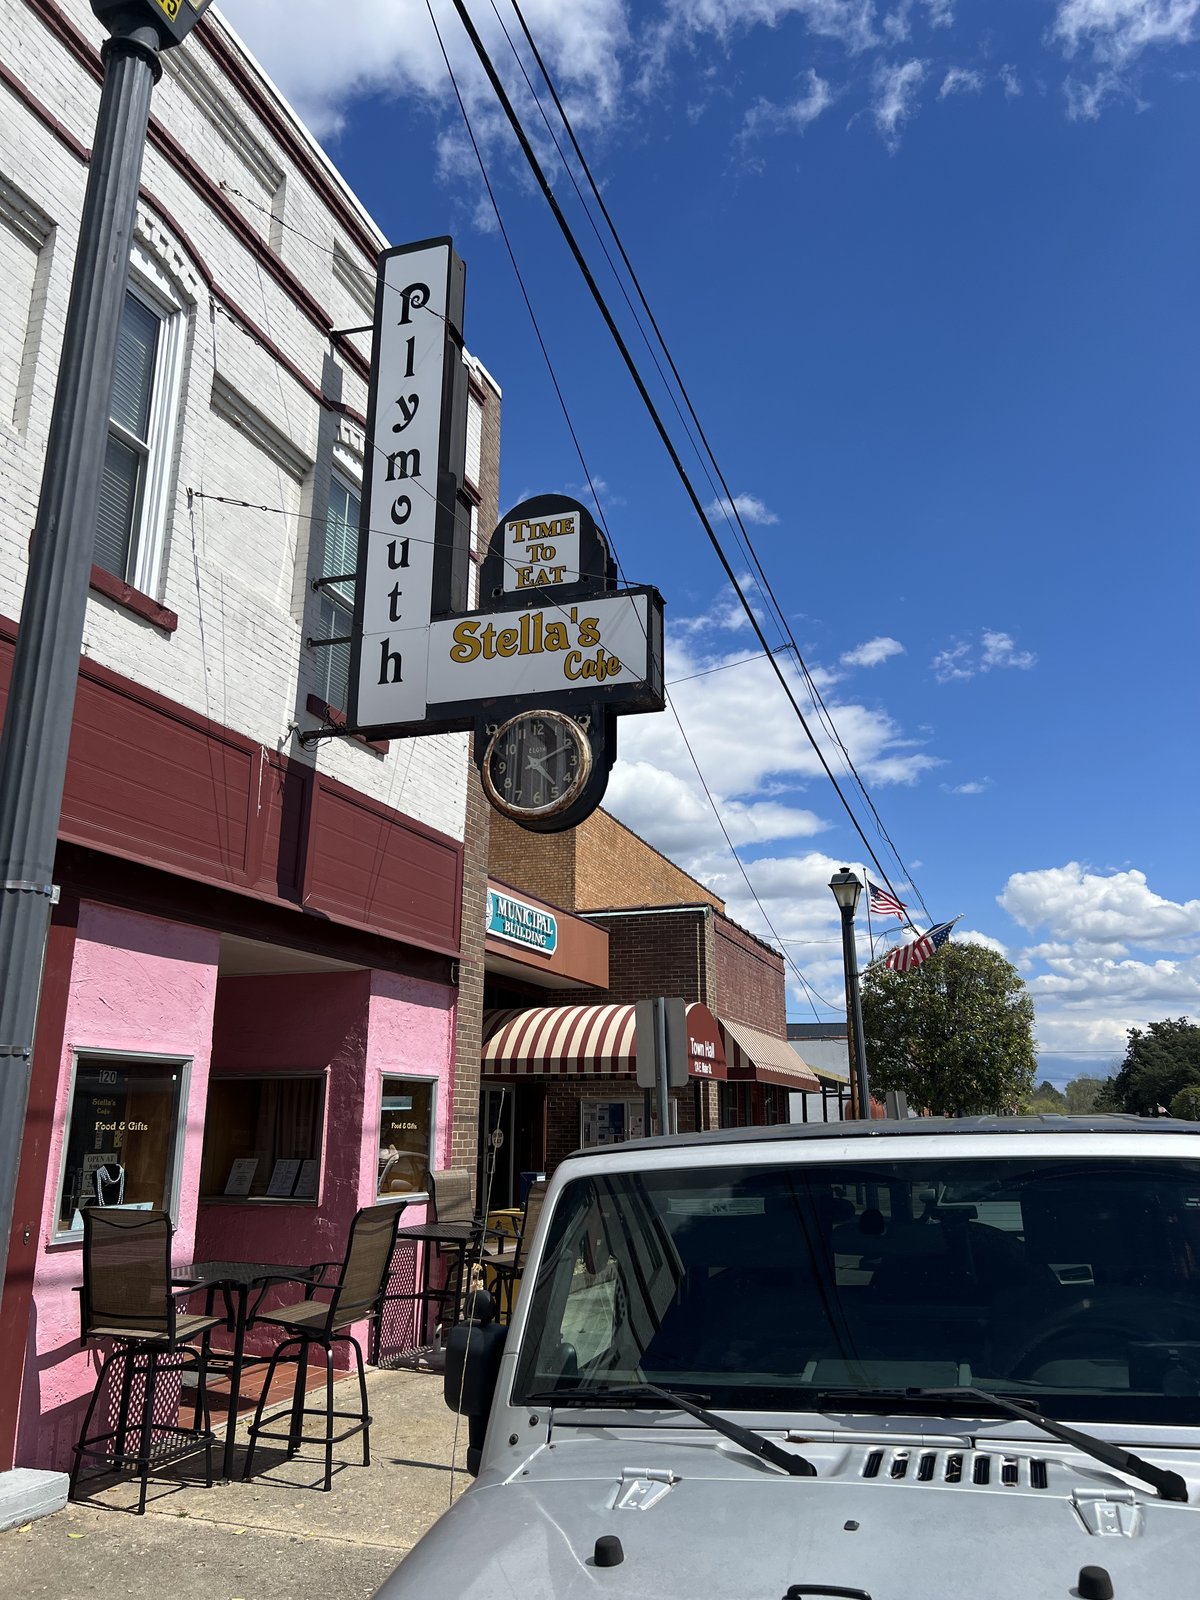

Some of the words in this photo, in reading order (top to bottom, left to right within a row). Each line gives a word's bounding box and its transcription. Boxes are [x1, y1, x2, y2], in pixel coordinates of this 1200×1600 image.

[377, 282, 430, 685] Plymouth
[508, 517, 575, 543] TIME
[515, 565, 566, 589] EAT
[450, 606, 601, 663] Stella's
[564, 649, 622, 682] Cafe
[518, 729, 526, 739] 11
[533, 724, 544, 736] 12
[505, 744, 517, 755] 10
[569, 755, 577, 766] 3
[498, 762, 506, 774] 9
[503, 777, 512, 788] 8
[563, 772, 572, 783] 4
[515, 791, 522, 801] 7
[533, 792, 540, 804] 6
[551, 787, 560, 798] 5
[497, 896, 554, 935] MUNICIPAL
[504, 920, 547, 946] BUILDING
[690, 1037, 705, 1057] Town
[92, 1098, 116, 1106] Stella's
[94, 1121, 116, 1131] Food
[118, 1121, 125, 1131] &
[127, 1121, 149, 1131] Gifts
[87, 1155, 104, 1163] OPEN
